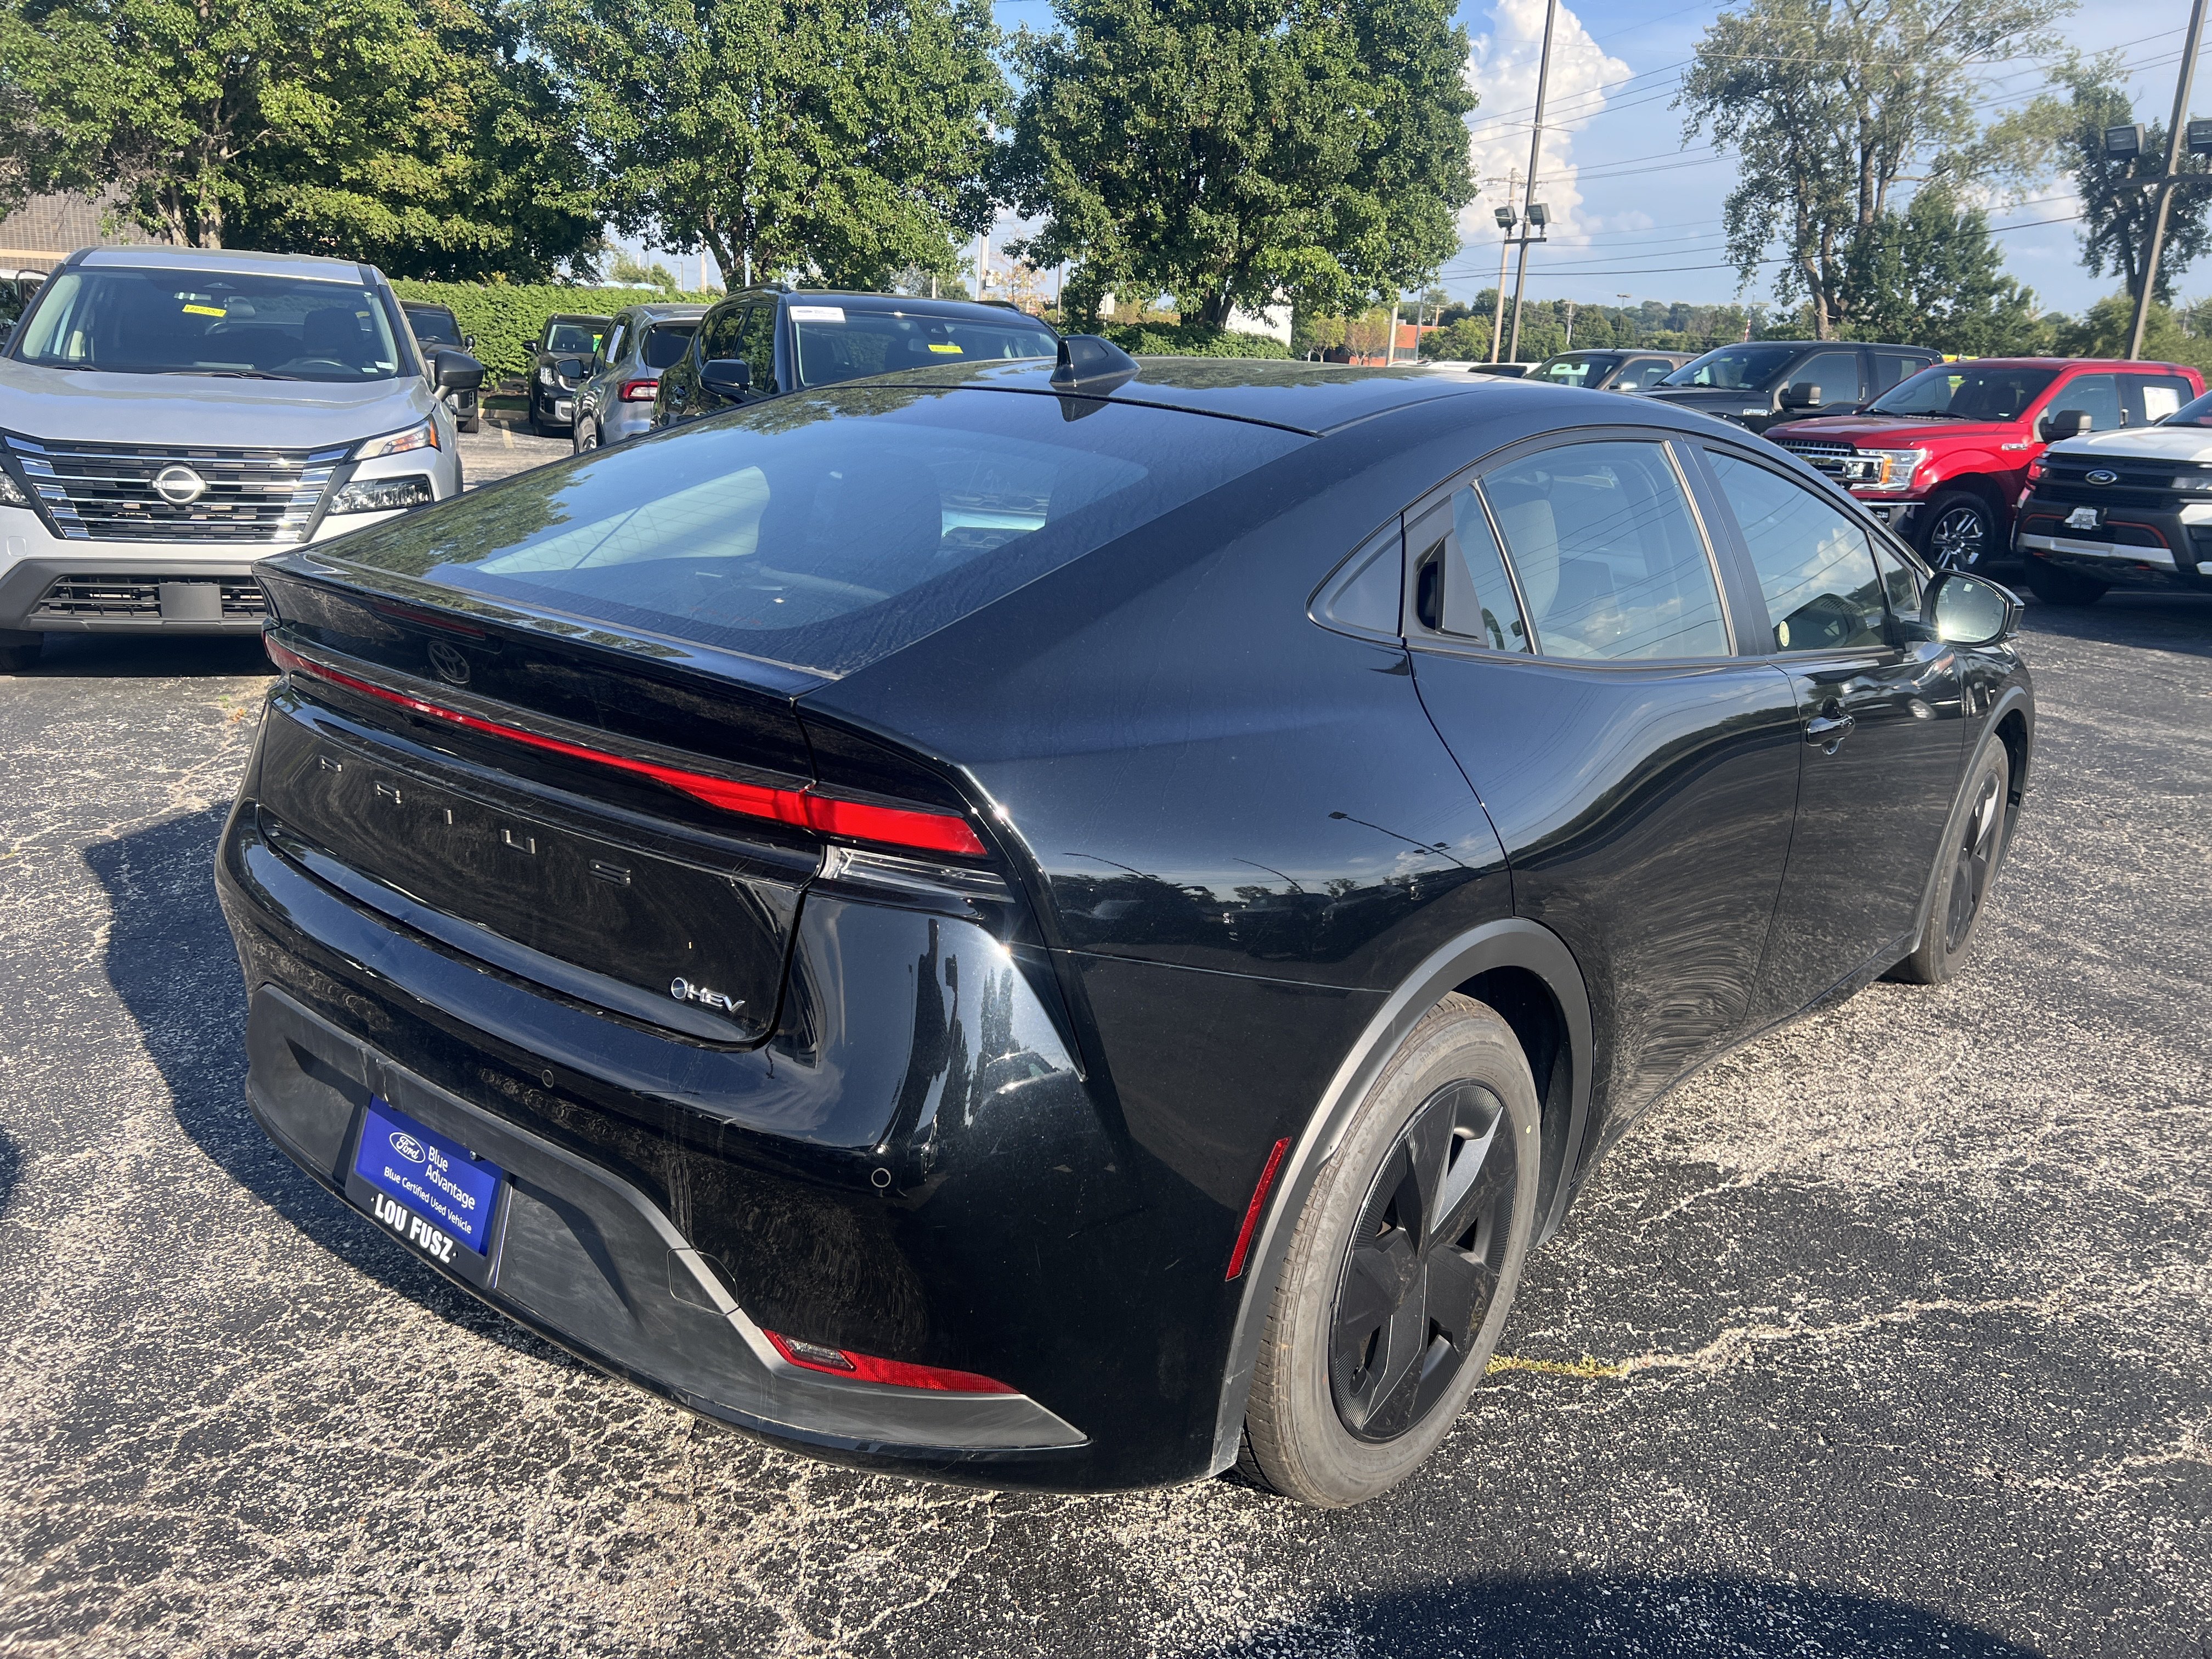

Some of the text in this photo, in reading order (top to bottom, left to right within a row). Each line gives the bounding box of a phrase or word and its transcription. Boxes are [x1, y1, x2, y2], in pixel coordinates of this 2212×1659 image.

[319, 754, 632, 885] PRIUS
[687, 984, 746, 1013] HEV
[396, 1135, 420, 1160] Ford
[428, 1146, 448, 1172] Blue
[384, 1166, 472, 1234] Blue Certified Used Vehicle
[425, 1164, 475, 1210] Advantage
[374, 1193, 454, 1263] LOU FUSZ
